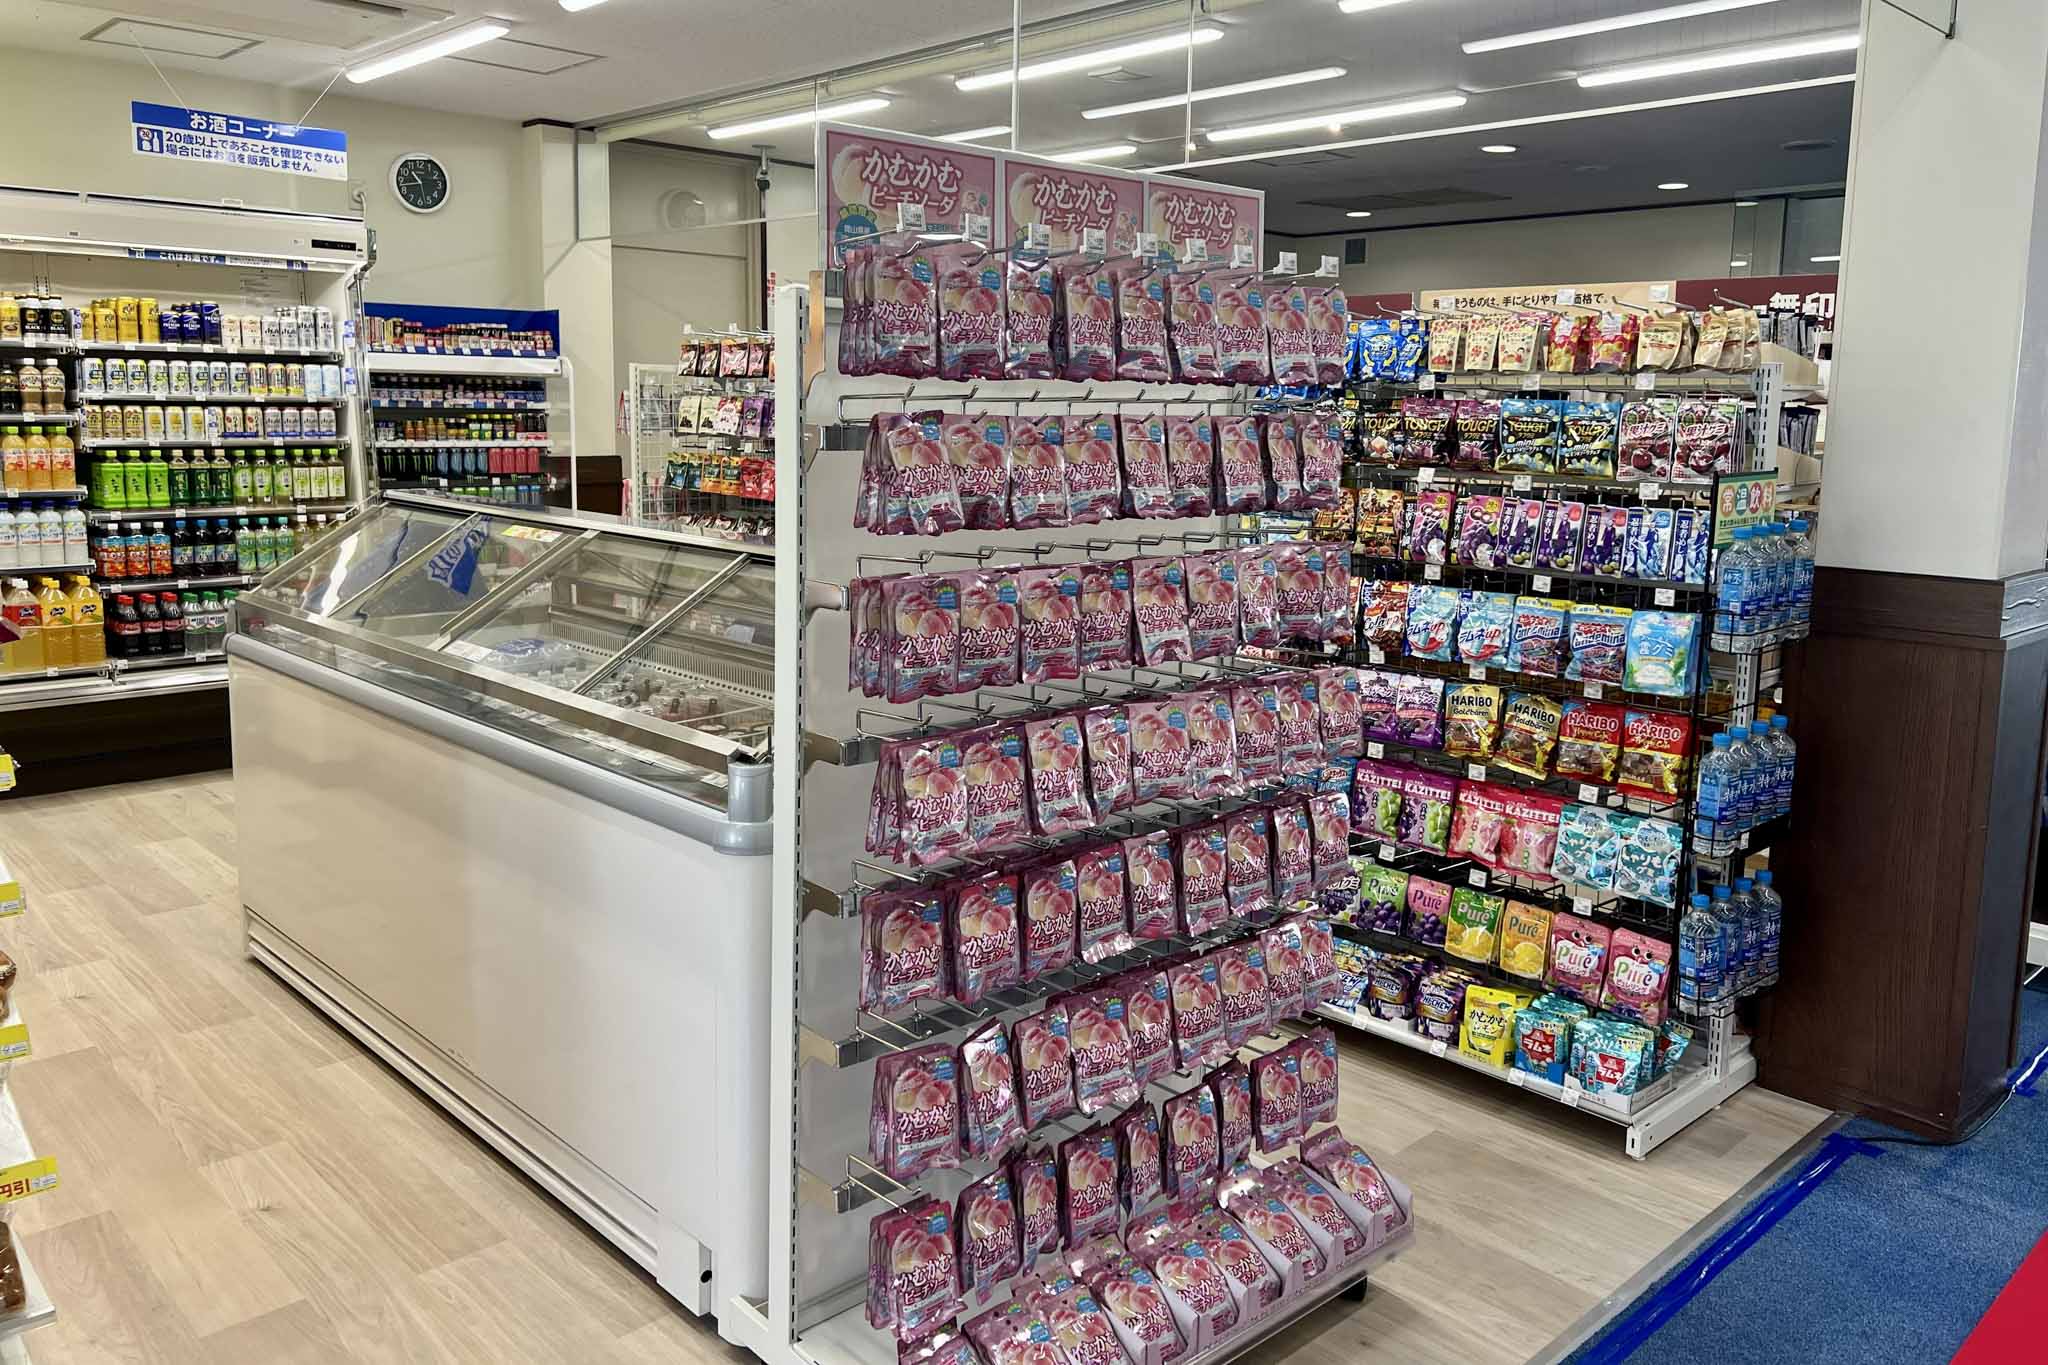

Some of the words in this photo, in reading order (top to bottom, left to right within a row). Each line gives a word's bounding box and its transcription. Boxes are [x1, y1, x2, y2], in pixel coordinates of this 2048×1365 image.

[189, 112, 298, 138] お酒コーナー
[165, 130, 344, 165] 20歳以上であることを確認できない
[862, 149, 963, 193] かむかむ
[870, 186, 957, 215] ピーチソーダ
[1035, 176, 1116, 213] かむかむ
[1040, 210, 1112, 233] ピーチソーダ
[1166, 195, 1236, 229] かむかむ
[1170, 225, 1232, 249] ピーチソーダ
[944, 311, 1001, 331] かむかむ
[1218, 325, 1265, 343] かむかむ
[1457, 418, 1497, 432] TOUGH
[1014, 465, 1062, 482] かむかむ
[1064, 462, 1116, 480] かむかむ
[1025, 618, 1078, 637] かむかむ
[1082, 610, 1128, 628] かむかむ
[900, 633, 957, 655] かむかむ
[961, 627, 1017, 645] かむかむ
[1451, 695, 1494, 708] HARIBO
[1514, 703, 1556, 724] HARIBO
[1568, 712, 1619, 731] HARIBO
[1629, 723, 1681, 742] HARIBO
[1138, 749, 1188, 767] かむかむ
[969, 780, 1023, 803] かむかむ
[1357, 773, 1402, 789] KAZITTE!
[1404, 782, 1450, 800] KAZITTE!
[1506, 804, 1560, 823] KAZITTE!
[1413, 889, 1442, 910] Puré
[1458, 901, 1490, 924] Puré
[1509, 917, 1539, 938] Puré
[965, 927, 1016, 956] かむかむ
[883, 945, 940, 972] かむかむ
[1558, 946, 1593, 968] Puré
[1224, 988, 1267, 1013] かむかむ
[1179, 1001, 1220, 1028] かむかむ
[1469, 1009, 1506, 1028] かむかむ
[1078, 1040, 1127, 1065] かむかむ
[1523, 1037, 1554, 1054] ラムネ
[898, 1103, 956, 1130] かむかむ
[899, 1254, 952, 1291] かむかむ
